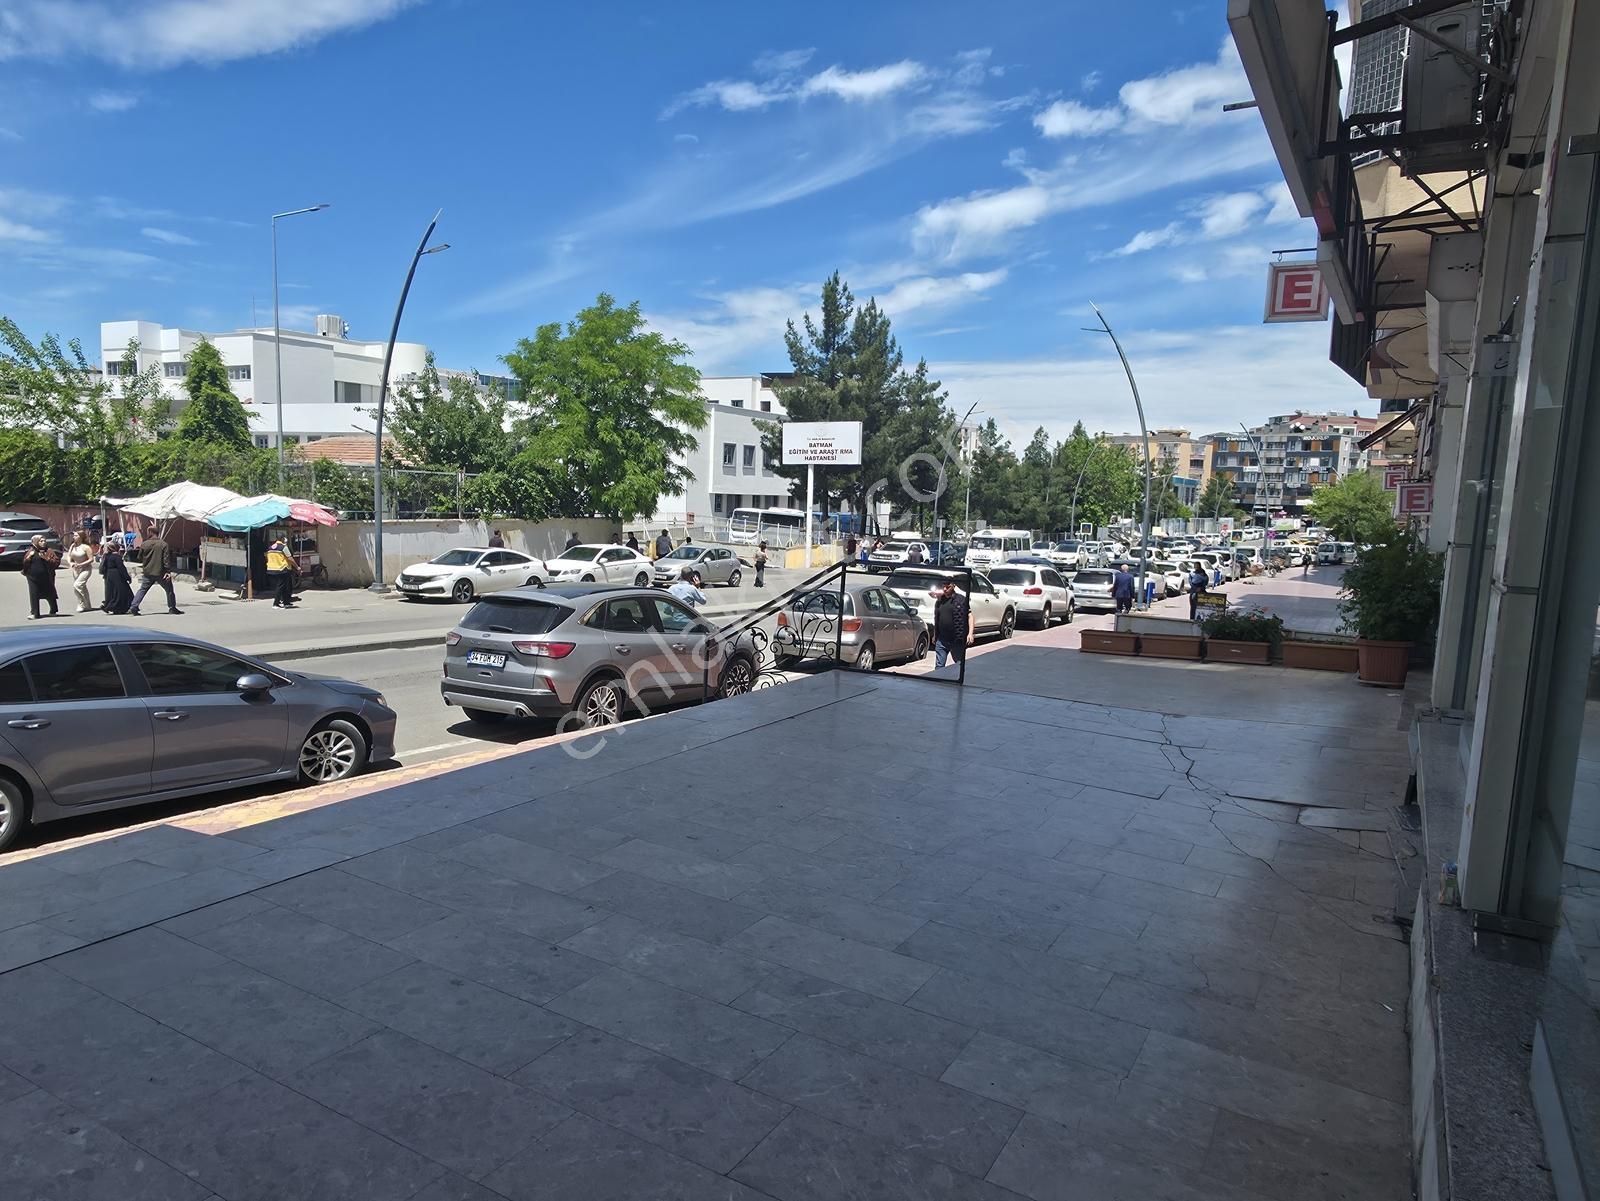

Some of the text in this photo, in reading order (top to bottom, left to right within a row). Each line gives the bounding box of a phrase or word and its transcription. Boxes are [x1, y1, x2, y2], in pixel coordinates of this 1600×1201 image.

[1281, 274, 1314, 309] E
[1406, 489, 1425, 509] E
[492, 655, 504, 665] 215
